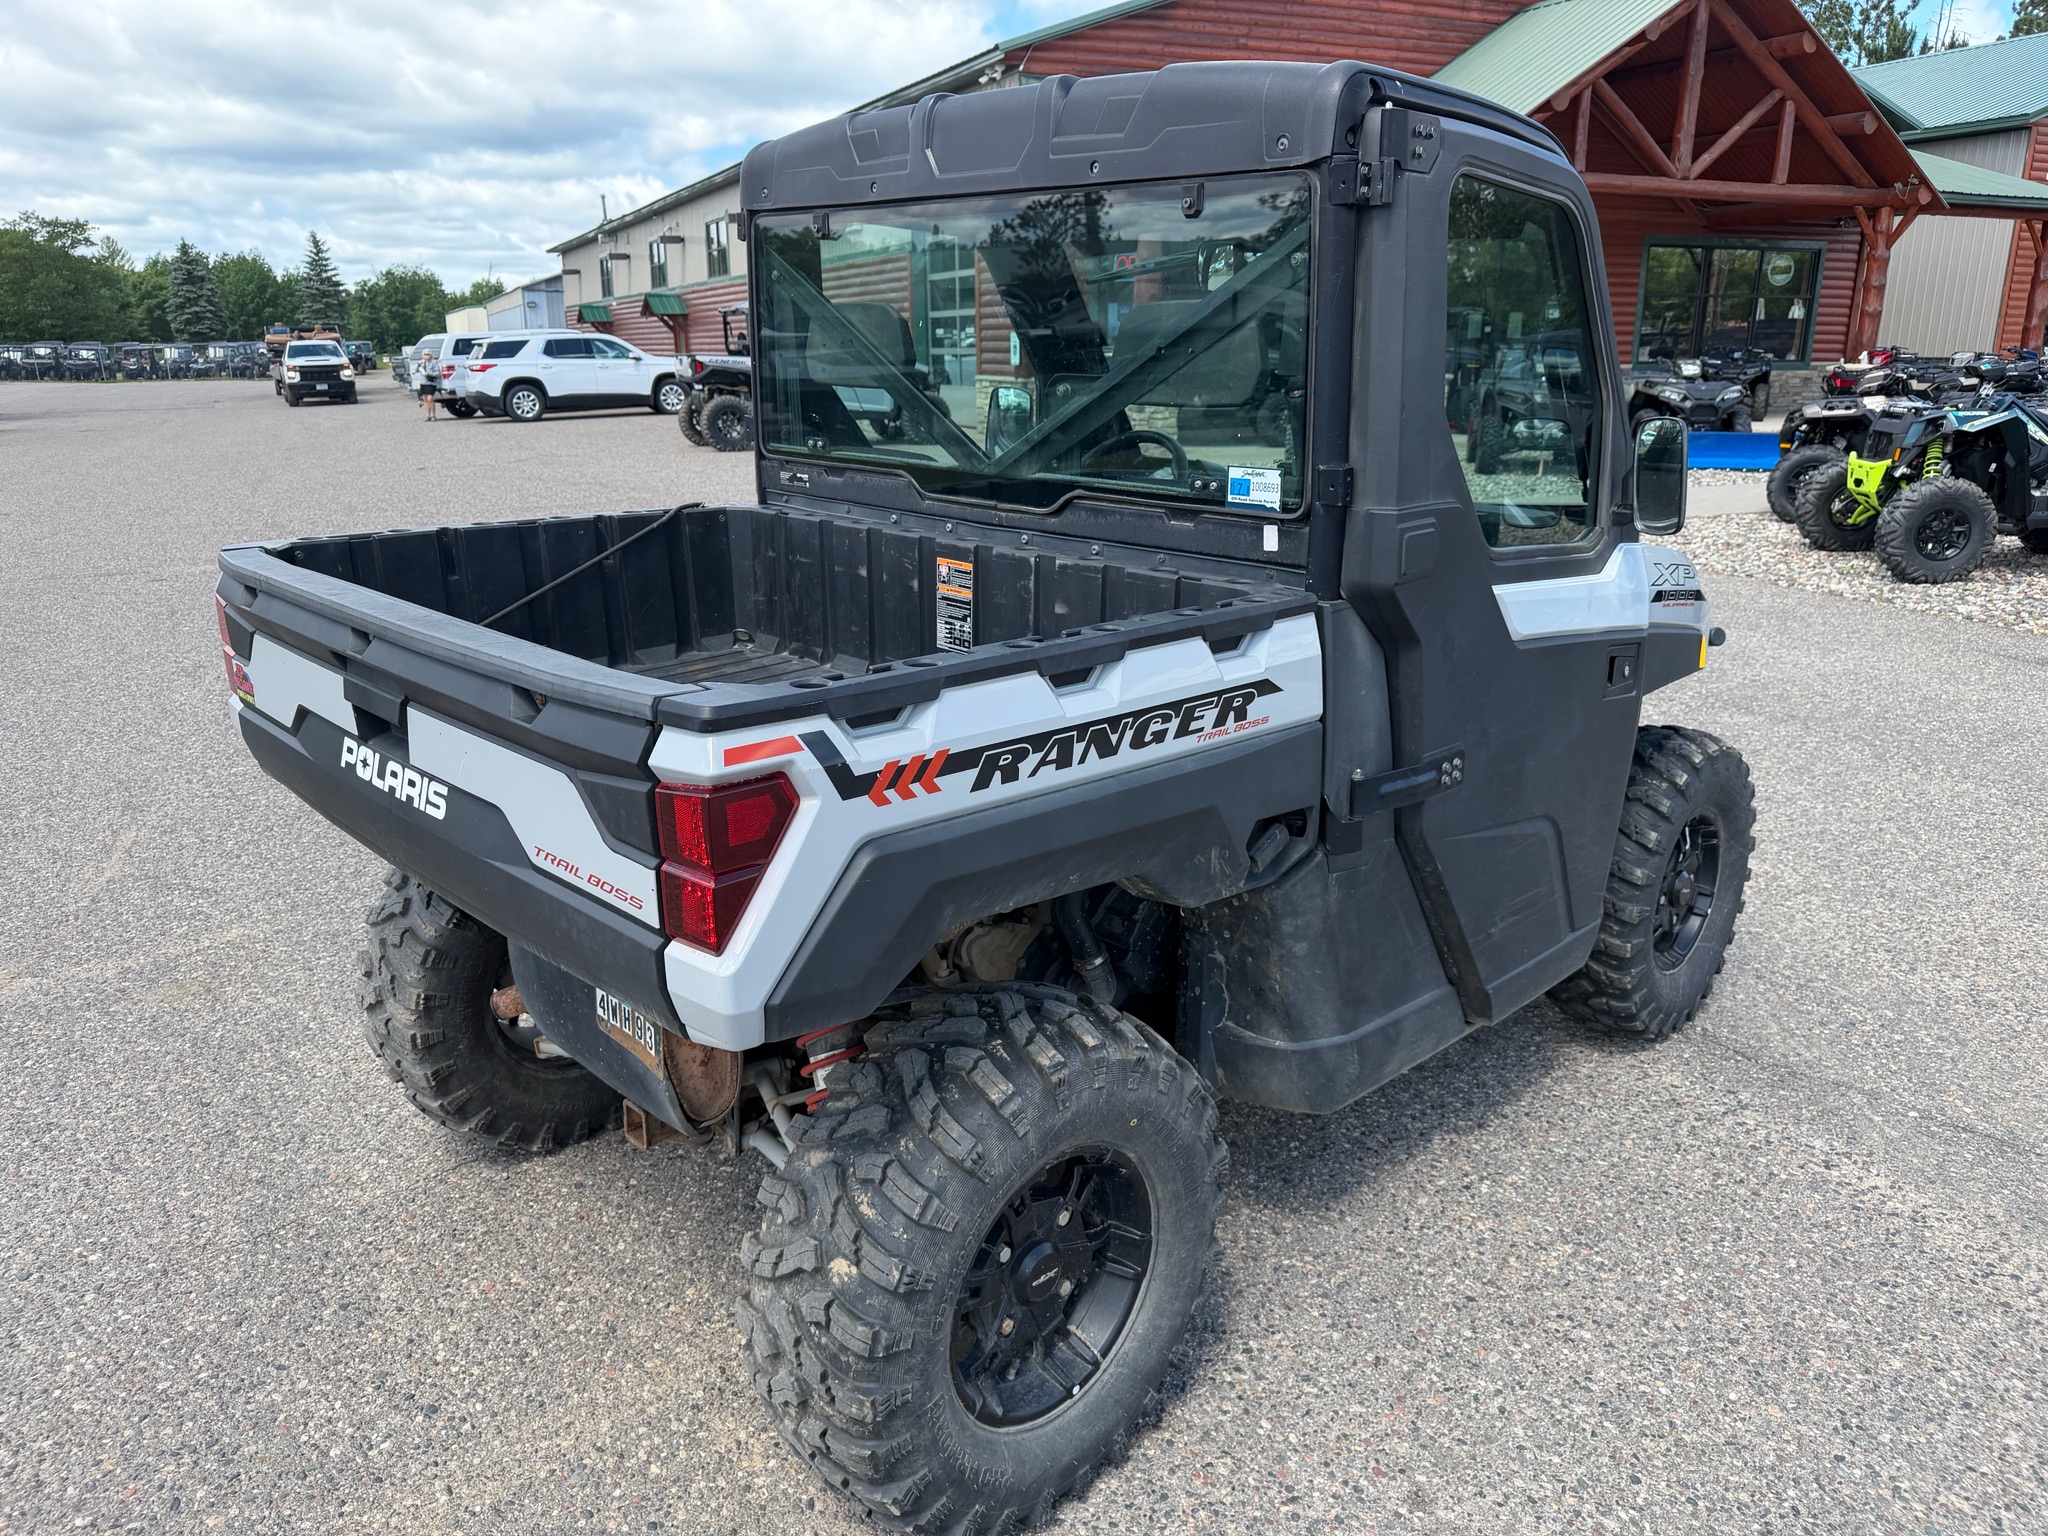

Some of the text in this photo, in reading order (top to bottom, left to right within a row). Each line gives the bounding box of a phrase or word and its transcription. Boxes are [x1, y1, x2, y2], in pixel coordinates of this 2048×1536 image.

[1237, 482, 1243, 494] 7
[1252, 482, 1279, 493] 1008693
[1650, 563, 1695, 586] XP
[1661, 589, 1697, 602] 1000
[969, 688, 1258, 793] RANGER
[1196, 715, 1270, 743] TRAIL BOSS
[340, 736, 448, 820] POLARIS
[534, 845, 644, 911] TRAIL BOSS
[598, 991, 655, 1053] 4WH93
